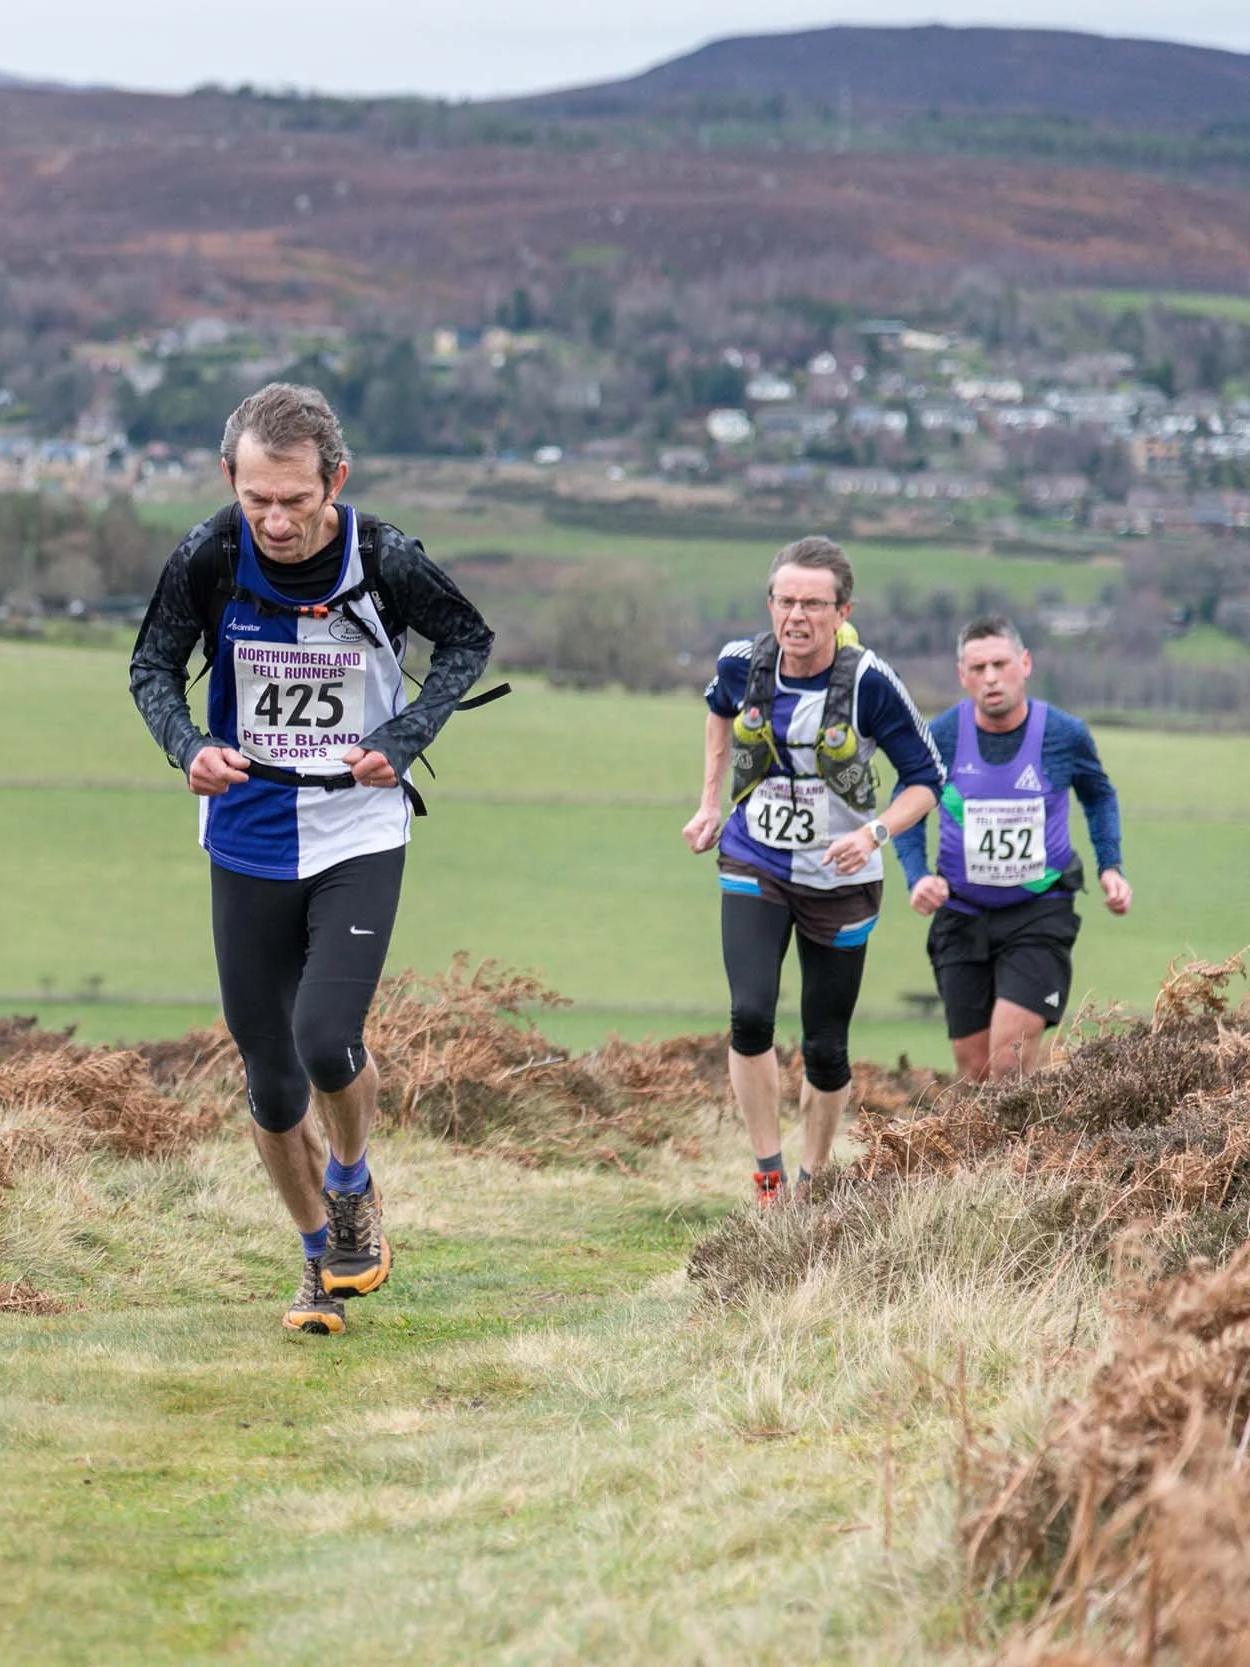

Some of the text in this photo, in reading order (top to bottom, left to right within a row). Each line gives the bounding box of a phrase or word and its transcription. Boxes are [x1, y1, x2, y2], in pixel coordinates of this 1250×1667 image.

[232, 623, 261, 632] Scimitar
[238, 647, 361, 666] NORTHUMBERLAND
[253, 664, 346, 680] FELL RUNNERS
[254, 682, 344, 728] 425
[243, 729, 360, 746] PETE BLAND
[270, 747, 328, 758] SPORTS
[757, 803, 815, 843] 423
[979, 828, 1034, 861] 452
